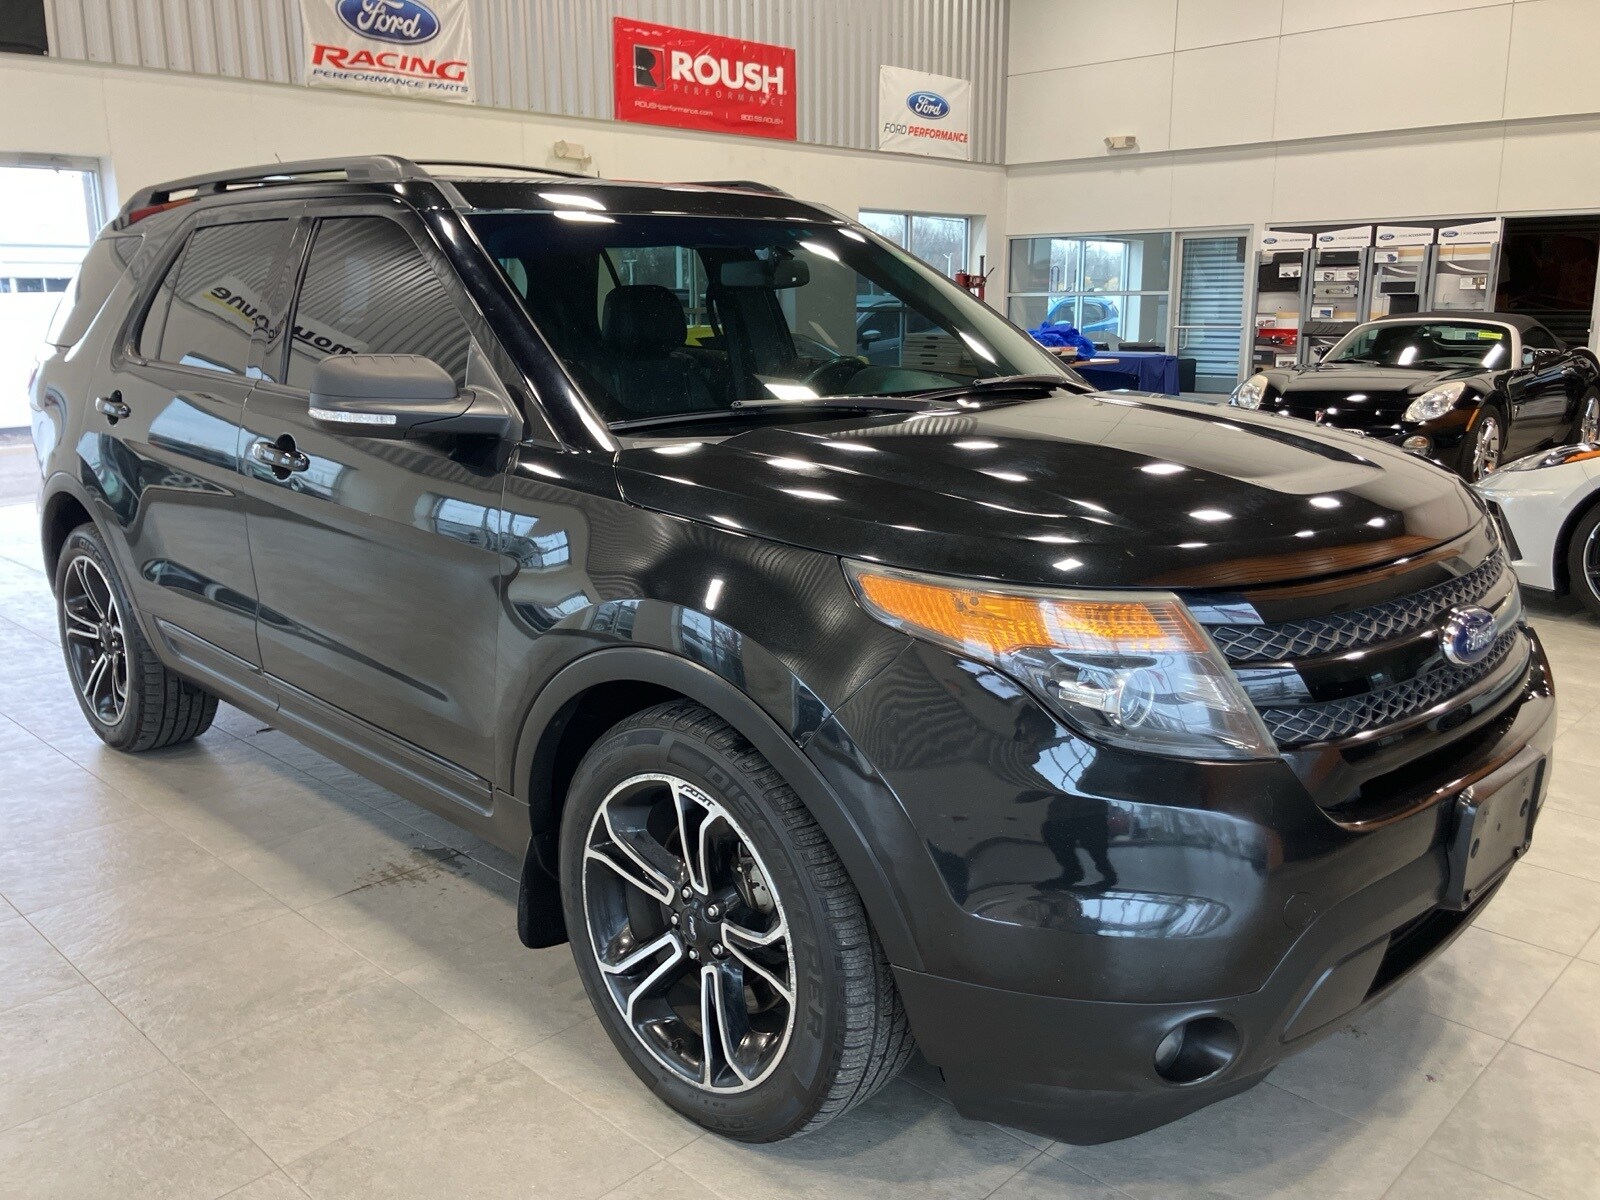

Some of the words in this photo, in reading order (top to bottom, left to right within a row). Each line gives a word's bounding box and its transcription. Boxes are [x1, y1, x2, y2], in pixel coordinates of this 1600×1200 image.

[357, 0, 421, 38] Ford
[312, 44, 467, 82] RACING
[671, 50, 784, 95] ROUSH
[312, 68, 424, 88] PERFORMANCE
[428, 82, 469, 93] PARTS
[673, 83, 784, 107] PERFORMANCE
[914, 95, 942, 115] Ford
[884, 122, 907, 135] FORD
[908, 126, 968, 143] PERFORMANCE
